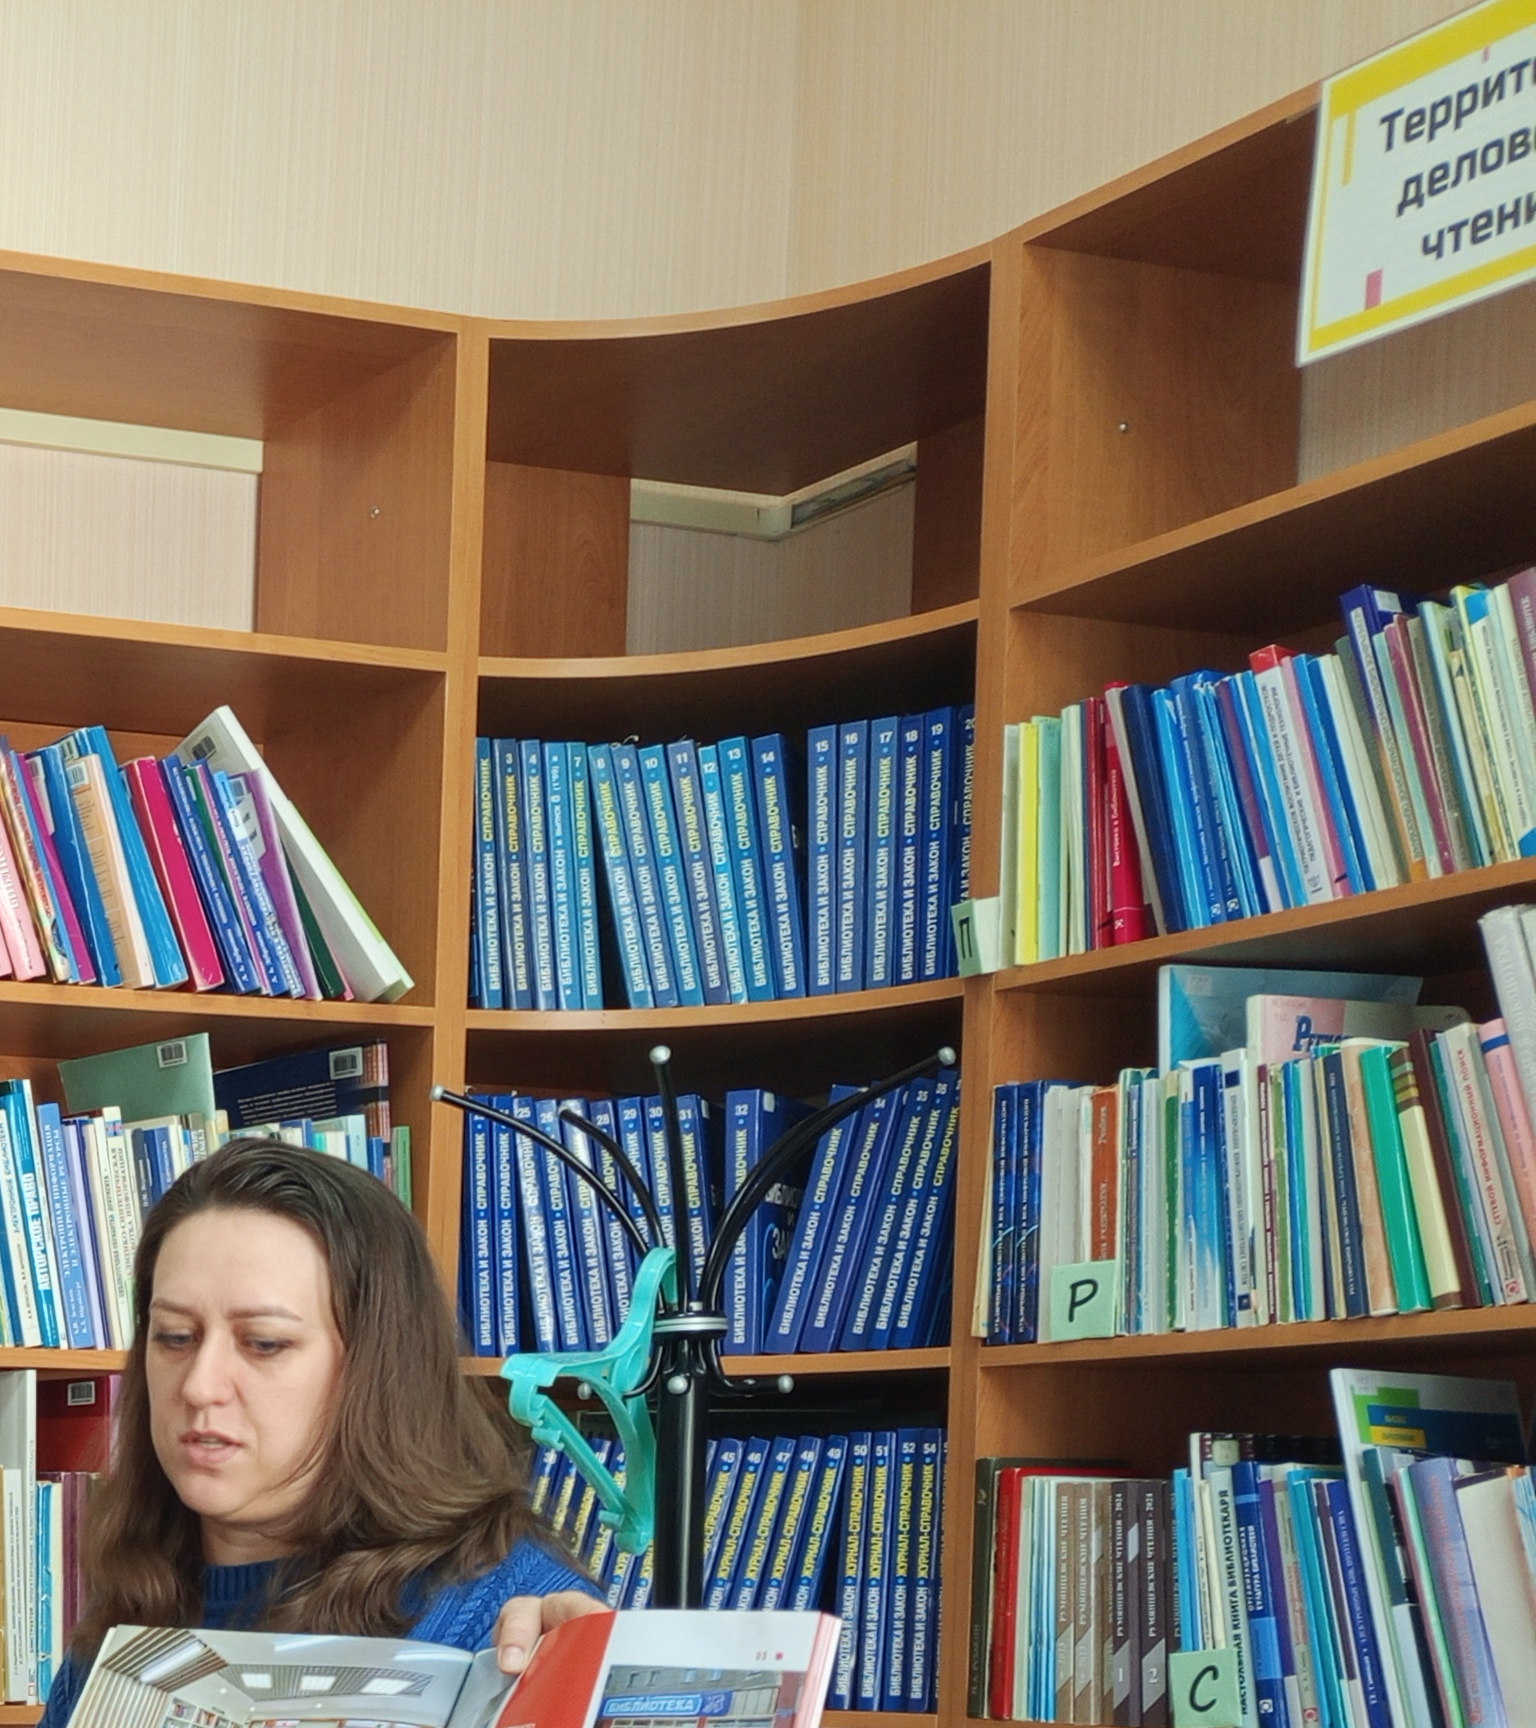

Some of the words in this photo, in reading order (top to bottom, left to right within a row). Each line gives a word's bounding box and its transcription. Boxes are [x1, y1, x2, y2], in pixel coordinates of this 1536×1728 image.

[1396, 126, 1536, 217] делов
[930, 722, 943, 735] 19
[929, 748, 943, 829] СПРАВОЧНИК
[927, 840, 940, 881] ЗАКОН
[927, 884, 939, 892] И
[924, 893, 939, 974] БИБЛИОТЕКА
[848, 1119, 880, 1197] СПРАВОЧНИК
[21, 1171, 40, 1215] ПРАВО
[836, 1203, 858, 1244] ЗАКОН
[27, 1217, 51, 1291] АВТОРСКОЕ
[833, 1243, 847, 1254] И
[814, 1252, 845, 1328] БИБЛИОТЕКА
[1068, 1278, 1099, 1323] Р
[895, 1463, 915, 1577] ЖУРНАЛ-СПРАВОЧНИК
[1219, 1488, 1238, 1586] БИБЛИОТЕКАРЯ
[892, 1584, 907, 1619] ЗАКОН
[892, 1619, 905, 1628] И
[1227, 1588, 1242, 1630] КНИГА
[887, 1627, 904, 1696] БИБЛИОТЕКА
[608, 1698, 695, 1713] БИБЛИОТЕКА
[1188, 1665, 1220, 1713] С
